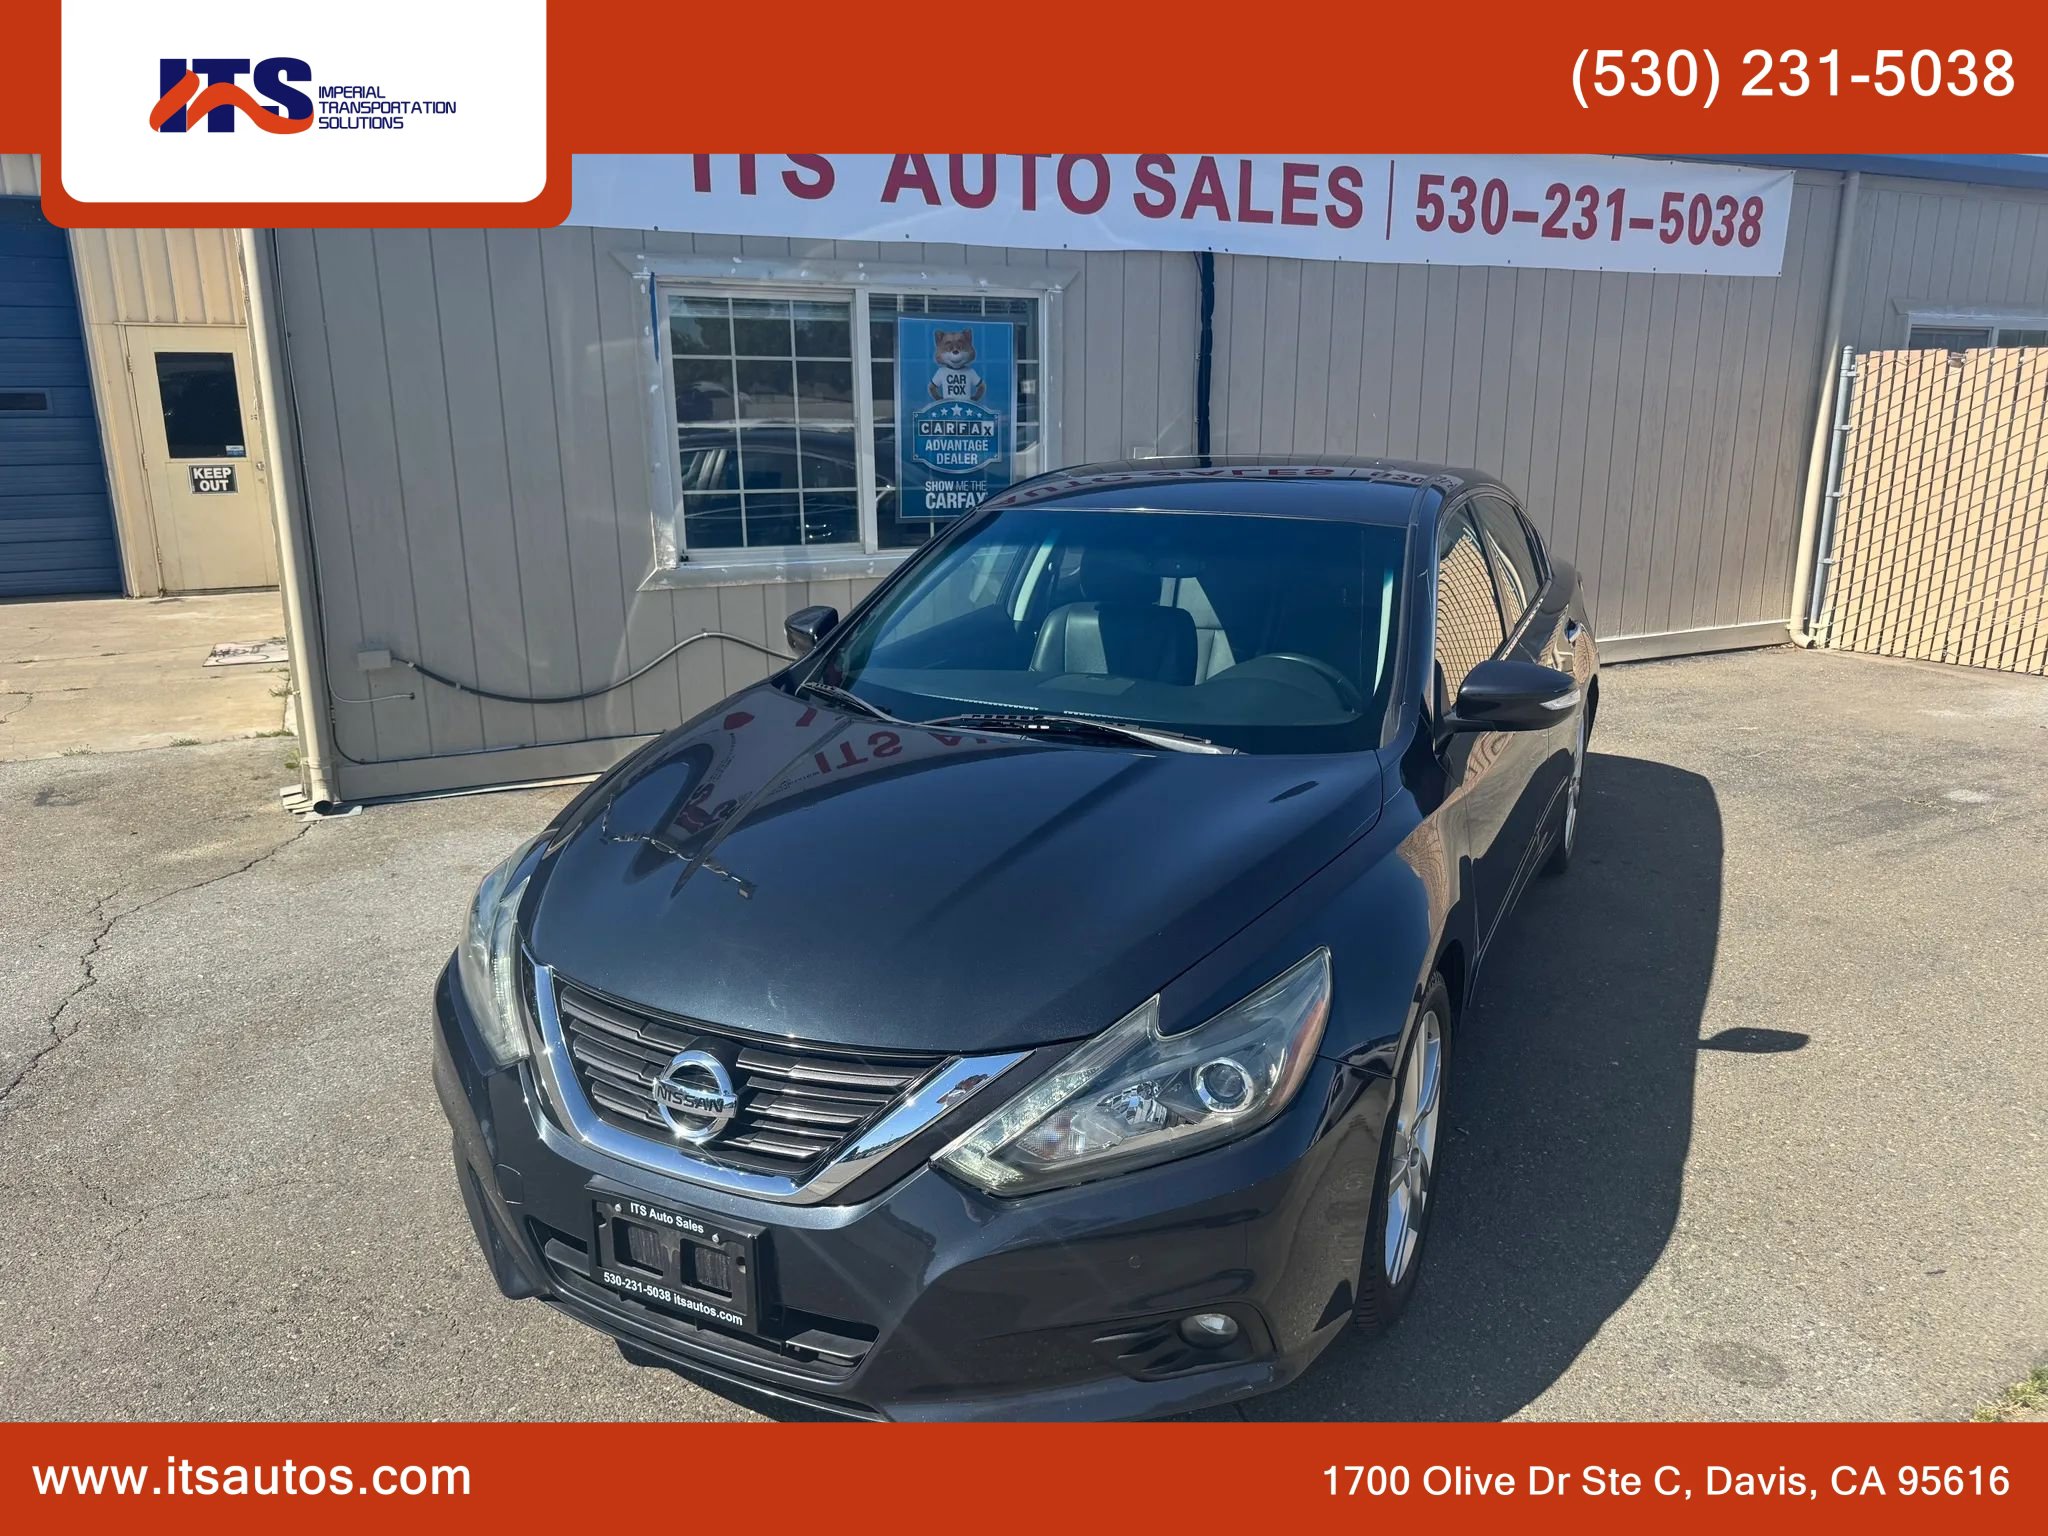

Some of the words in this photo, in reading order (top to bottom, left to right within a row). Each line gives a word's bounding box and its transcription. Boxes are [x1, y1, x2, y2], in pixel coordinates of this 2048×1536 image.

[880, 154, 1111, 214] AUTO
[1133, 155, 1365, 229] SALES
[1416, 174, 1766, 249] 530-231-5038
[946, 374, 967, 385] CAR
[947, 384, 967, 396] FOX
[919, 421, 994, 437] CARFAX
[925, 439, 989, 452] ADVANTAGE
[936, 453, 978, 465] DEALER
[193, 467, 232, 480] KEEP
[199, 479, 229, 492] OUT
[925, 480, 953, 492] SHOW
[956, 480, 969, 491] ME
[971, 480, 987, 491] THE
[657, 1085, 725, 1113] NISSAN
[630, 1202, 648, 1217] ITS
[649, 1208, 674, 1225] Auto
[676, 1216, 705, 1234] Sales
[603, 1271, 672, 1302] 530-231-5038
[673, 1292, 744, 1326] itsautos.com
